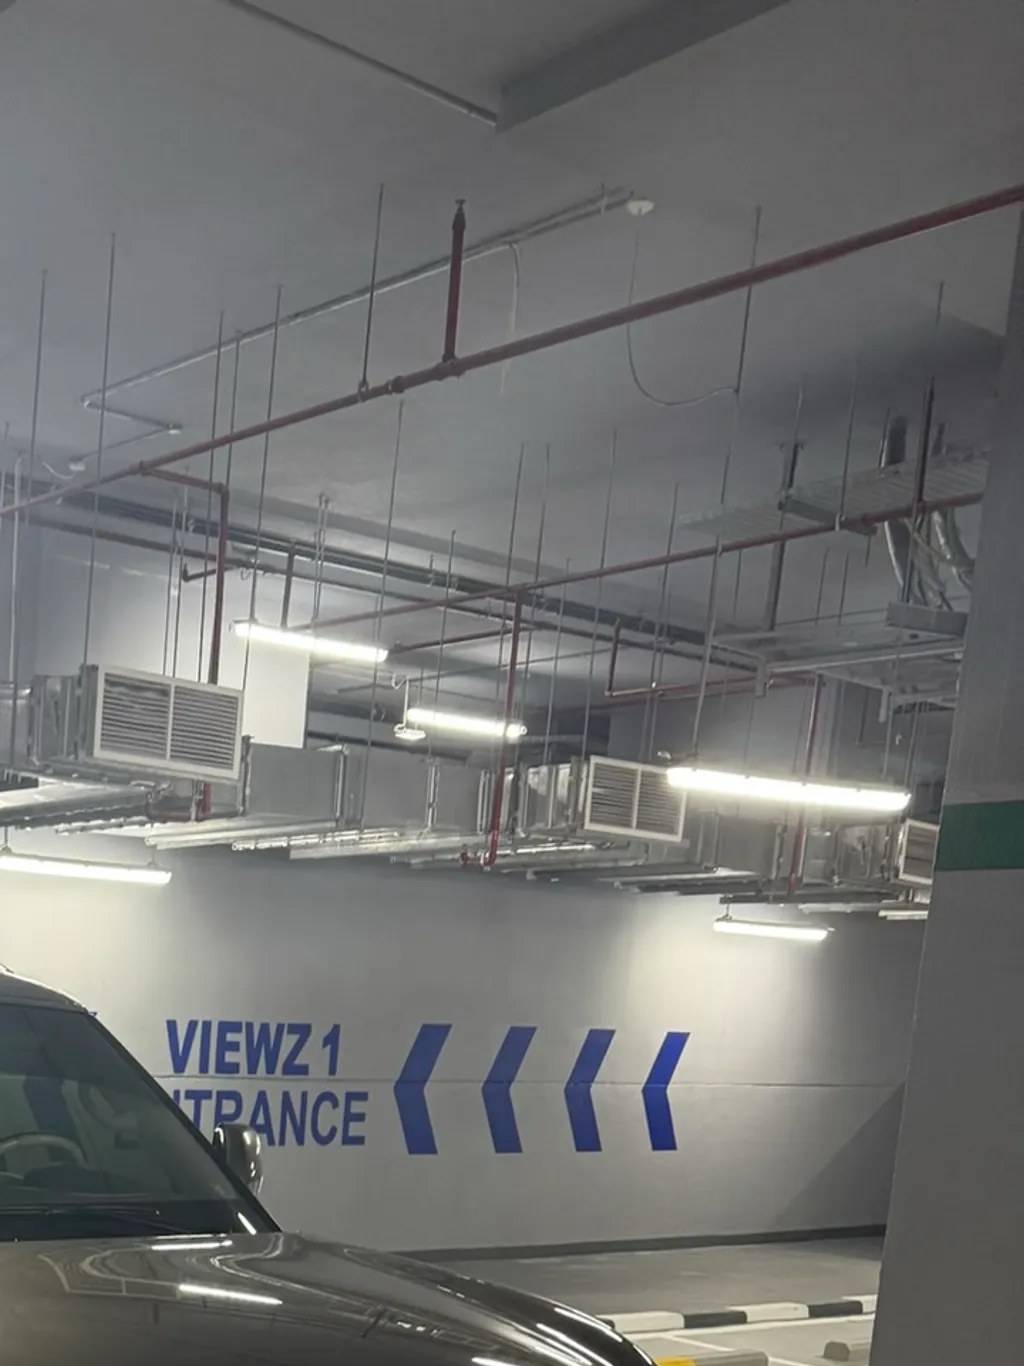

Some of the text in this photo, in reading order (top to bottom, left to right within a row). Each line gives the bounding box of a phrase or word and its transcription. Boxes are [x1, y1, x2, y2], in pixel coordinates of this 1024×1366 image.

[166, 1019, 341, 1077] VIEWZ 1
[173, 1089, 369, 1147] TRANCE
